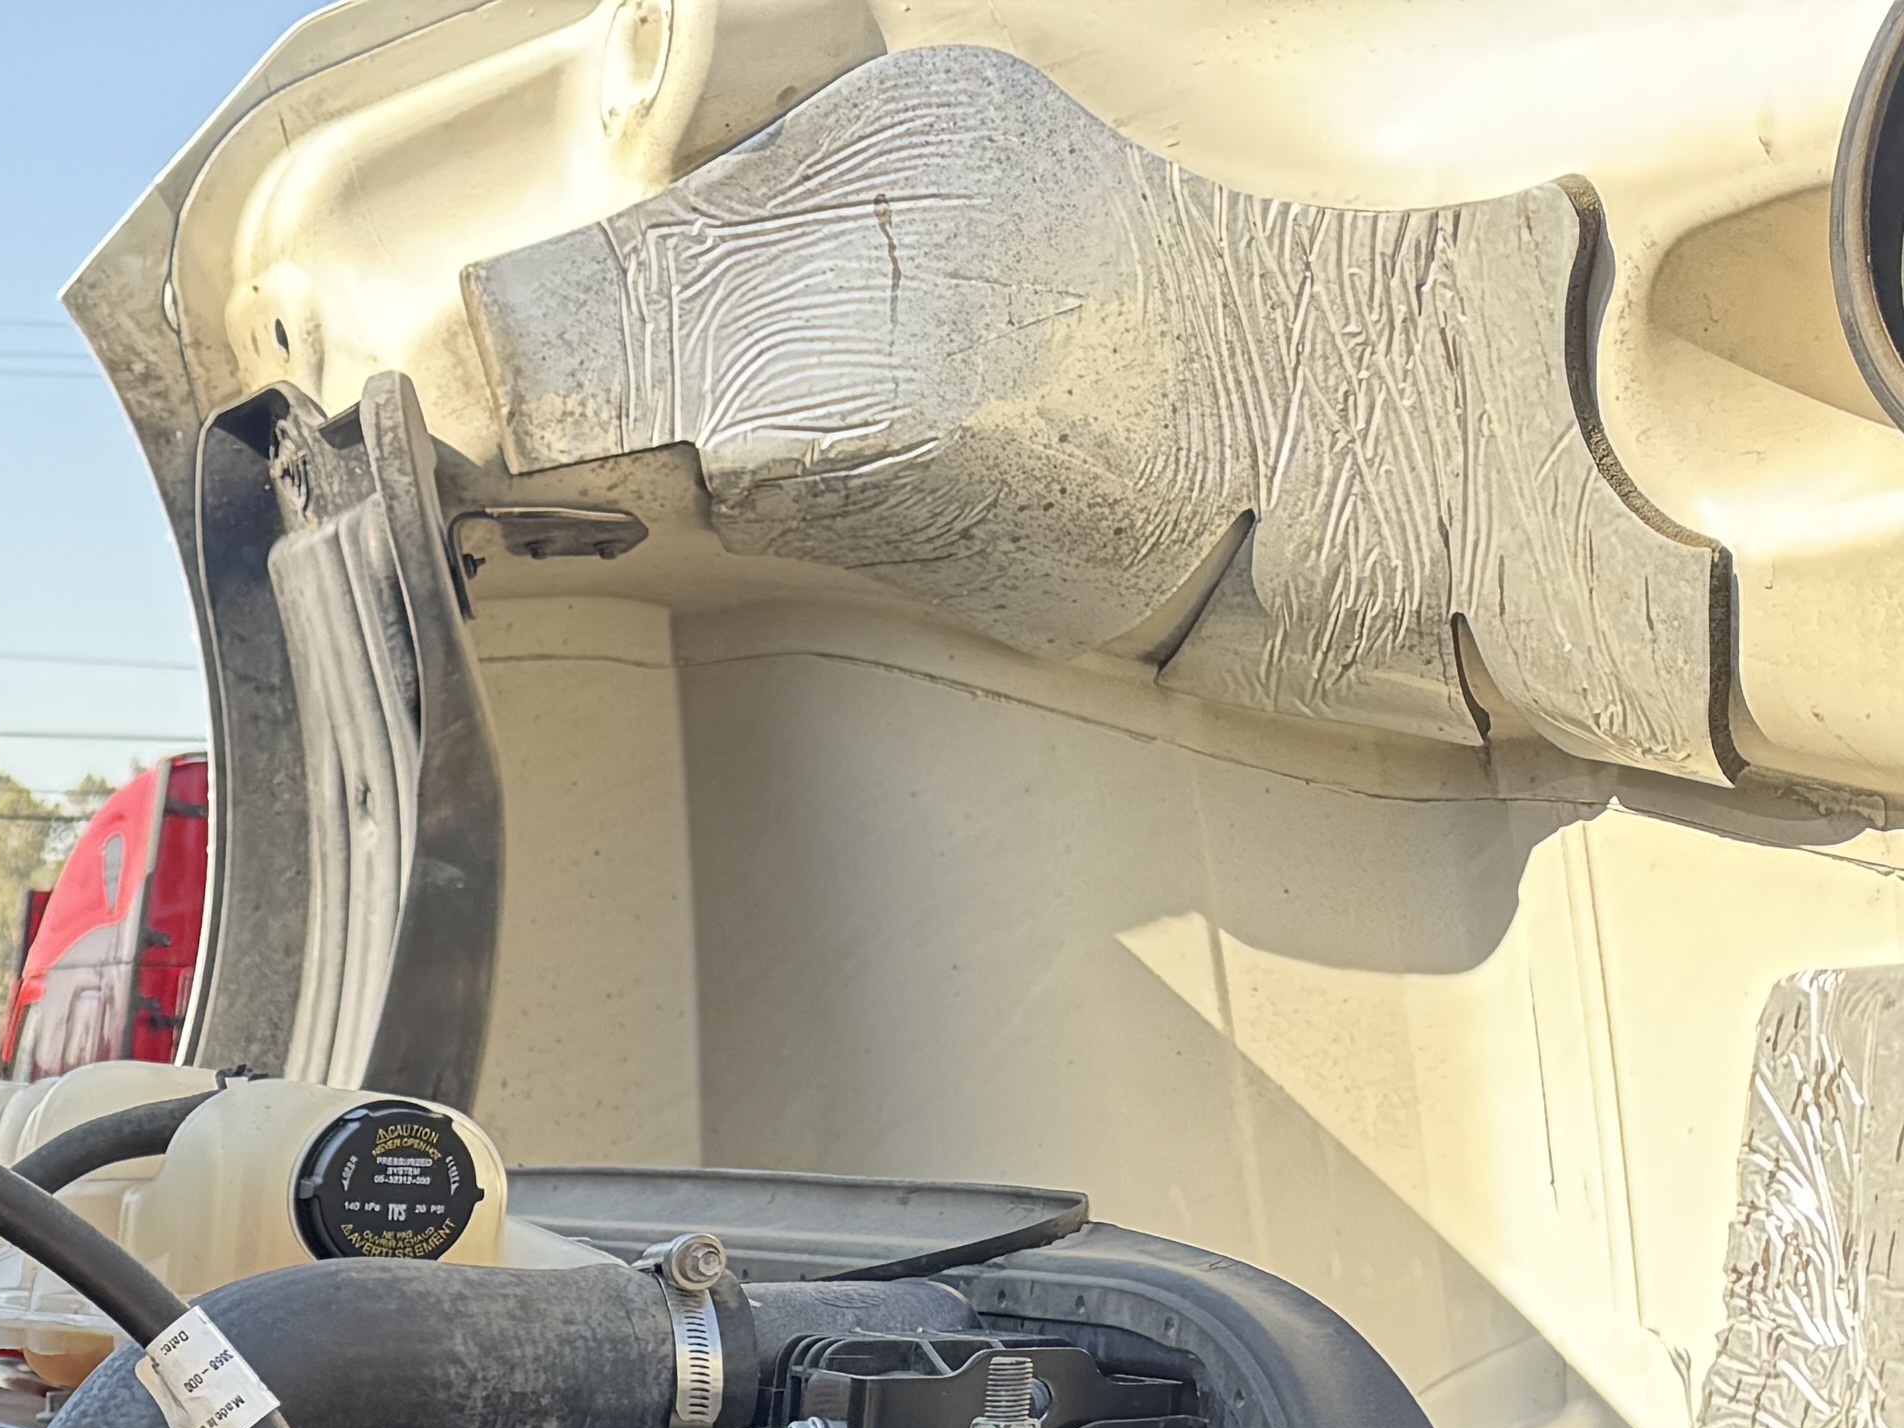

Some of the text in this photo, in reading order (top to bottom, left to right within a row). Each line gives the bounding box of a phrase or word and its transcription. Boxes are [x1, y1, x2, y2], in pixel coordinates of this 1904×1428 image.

[388, 1124, 440, 1143] CAUTION
[372, 1138, 401, 1156] NEVER
[402, 1138, 426, 1151] OPEN
[376, 1156, 433, 1167] PRESSURIZED
[386, 1166, 421, 1175] SYSTEM
[344, 1201, 361, 1211] 140
[414, 1204, 445, 1214] 20 PSI
[347, 1217, 455, 1259] AVERTISSEMENT
[216, 1395, 246, 1421] Made
